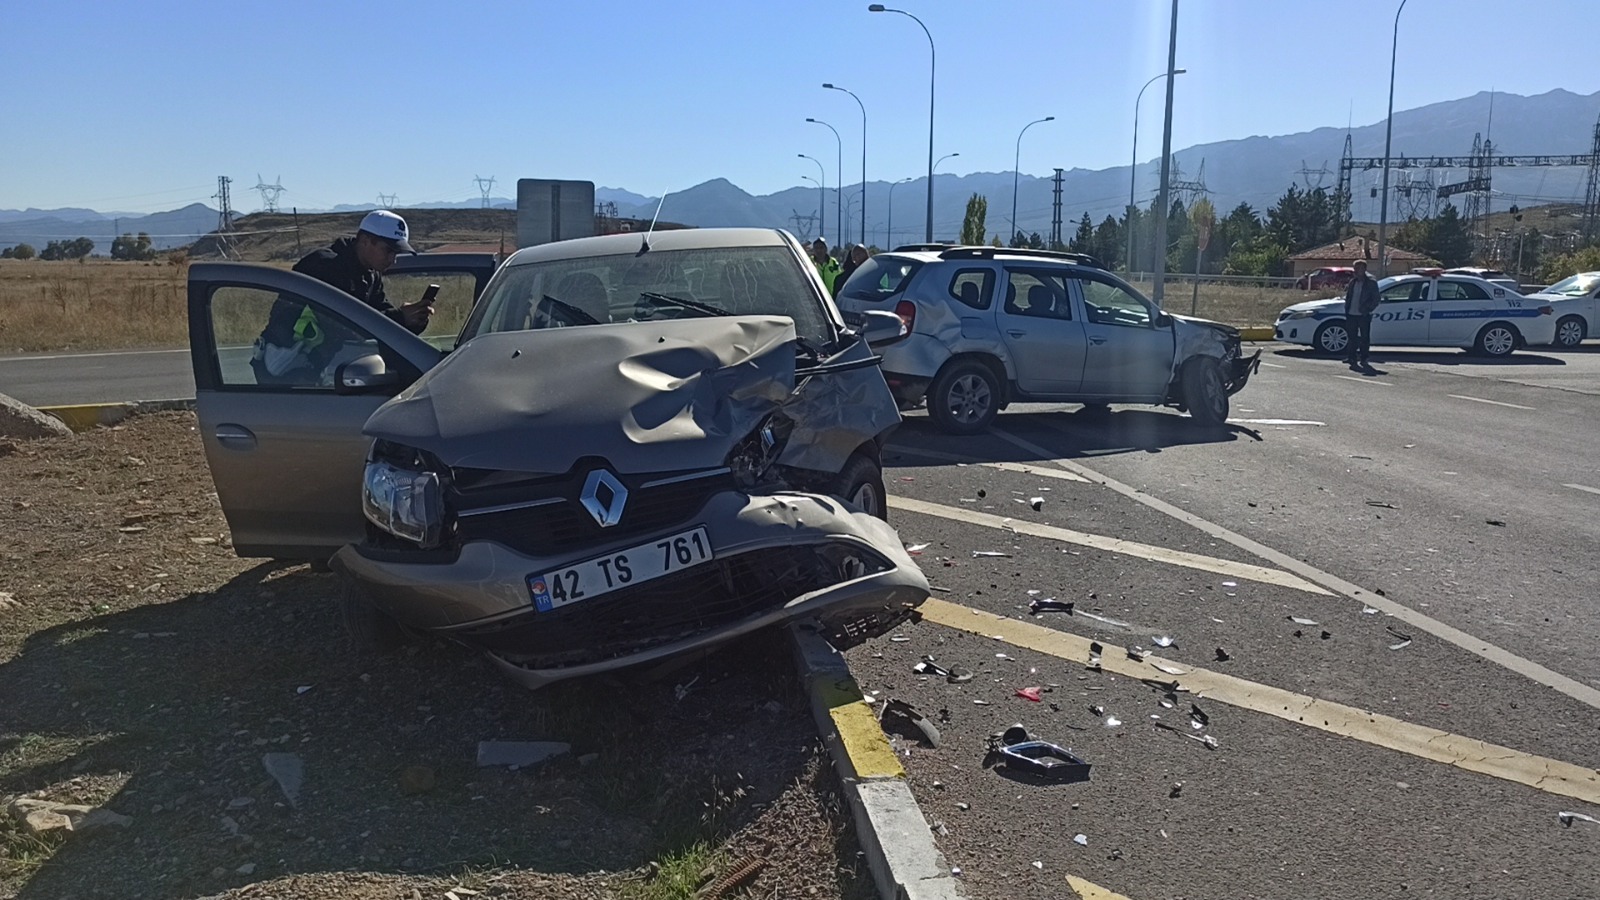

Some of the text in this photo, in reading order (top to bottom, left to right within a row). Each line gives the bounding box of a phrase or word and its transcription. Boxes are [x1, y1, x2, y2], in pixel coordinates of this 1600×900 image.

[536, 532, 705, 605] TR 42 TS 761
